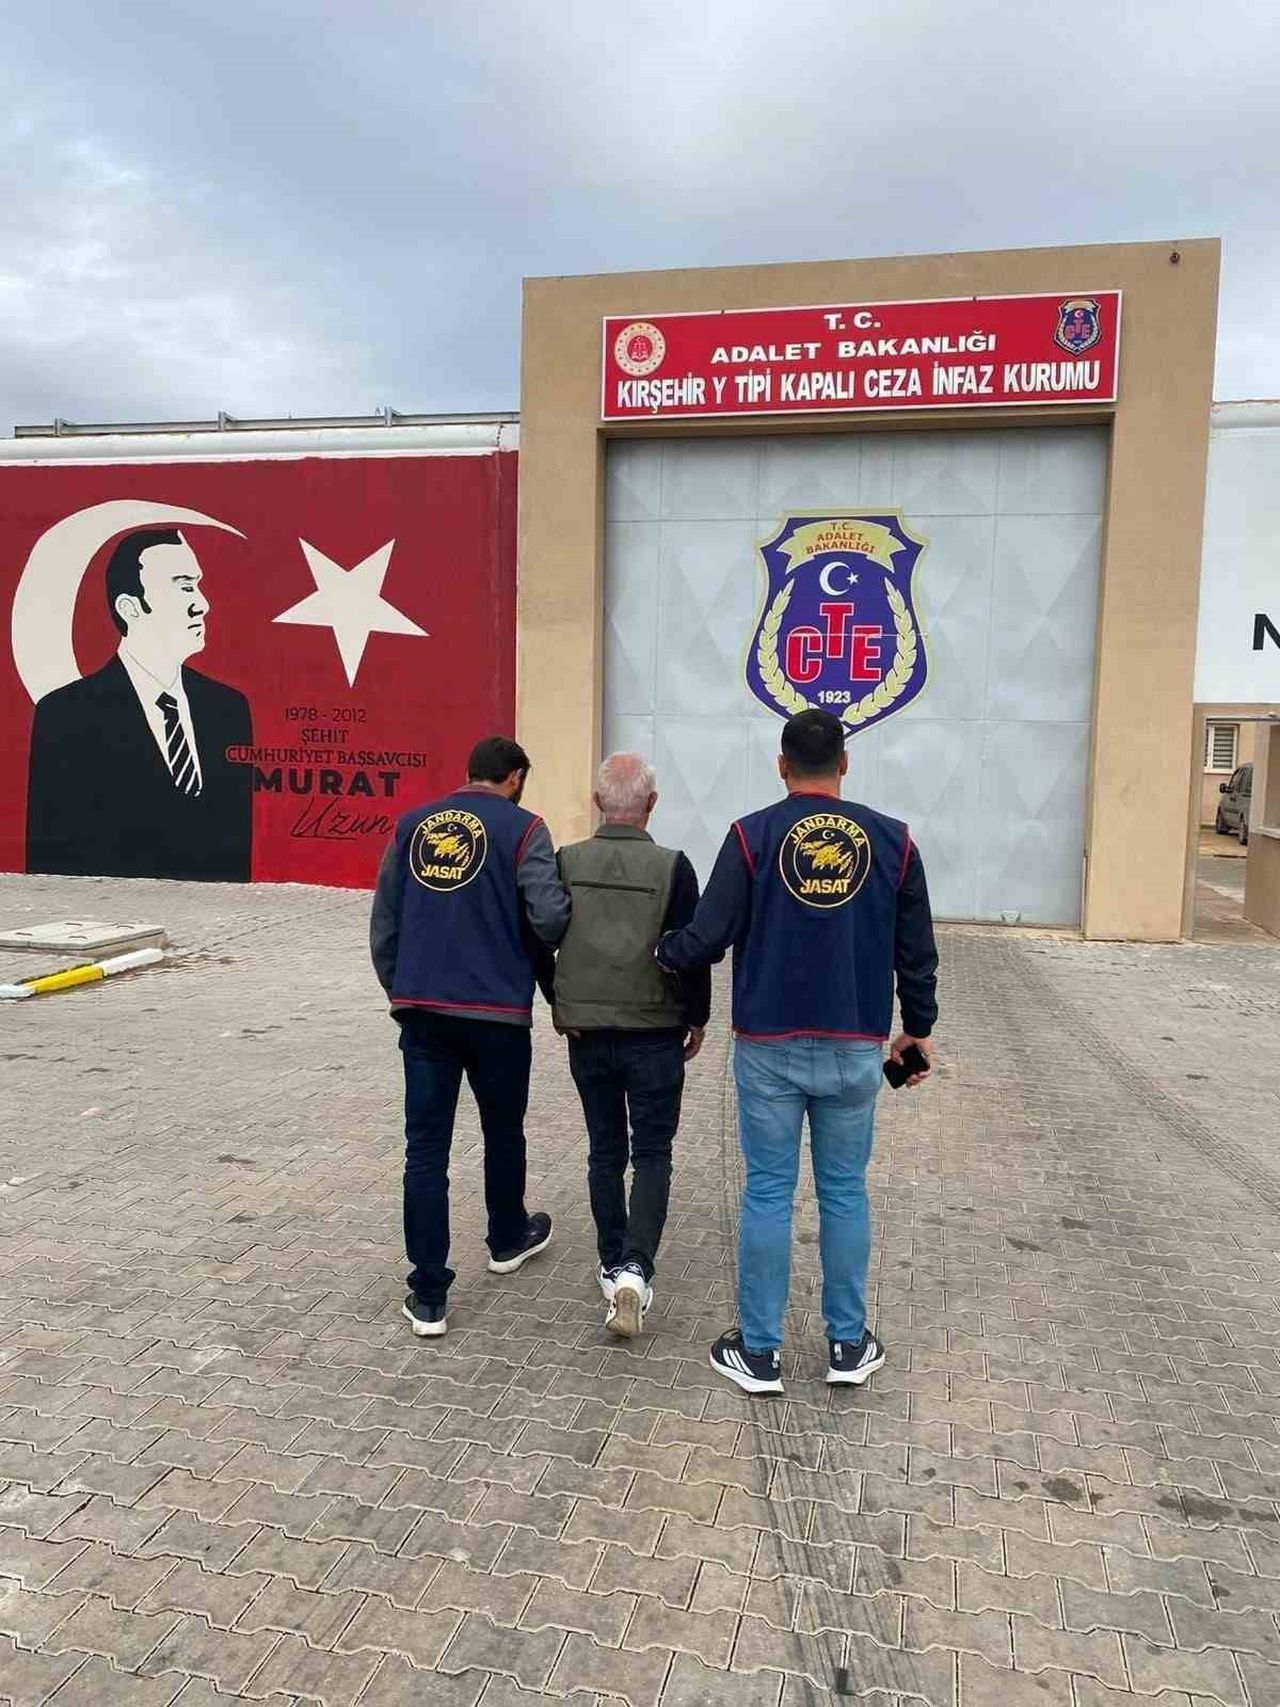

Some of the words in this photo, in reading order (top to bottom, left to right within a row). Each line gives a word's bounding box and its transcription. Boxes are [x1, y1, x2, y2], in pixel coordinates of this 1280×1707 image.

[824, 314, 846, 330] T.
[853, 312, 881, 329] C.
[711, 343, 821, 363] ADALET
[838, 330, 996, 357] BAKANLIĞI
[617, 372, 706, 413] KIRŞEHİR
[712, 377, 727, 404] Y
[735, 368, 771, 403] TİPİ
[780, 371, 855, 401] KAPALI
[863, 368, 922, 398] CEZA
[932, 361, 994, 395] İNFAZ
[1003, 360, 1100, 393] KURUMU
[817, 532, 863, 541] ADALET
[806, 541, 876, 554] BAKANLIĞI
[786, 602, 882, 683] CTE
[817, 691, 851, 704] 1923
[285, 707, 318, 721] 1978
[332, 708, 367, 723] 2012
[227, 746, 334, 763] CUMHURİYET
[253, 768, 400, 797] MURAT
[290, 797, 395, 839] Uzun
[420, 812, 483, 839] JANDARMA
[790, 817, 866, 847] JANDARMA
[421, 864, 465, 880] JASAT
[800, 879, 851, 893] JASAT
